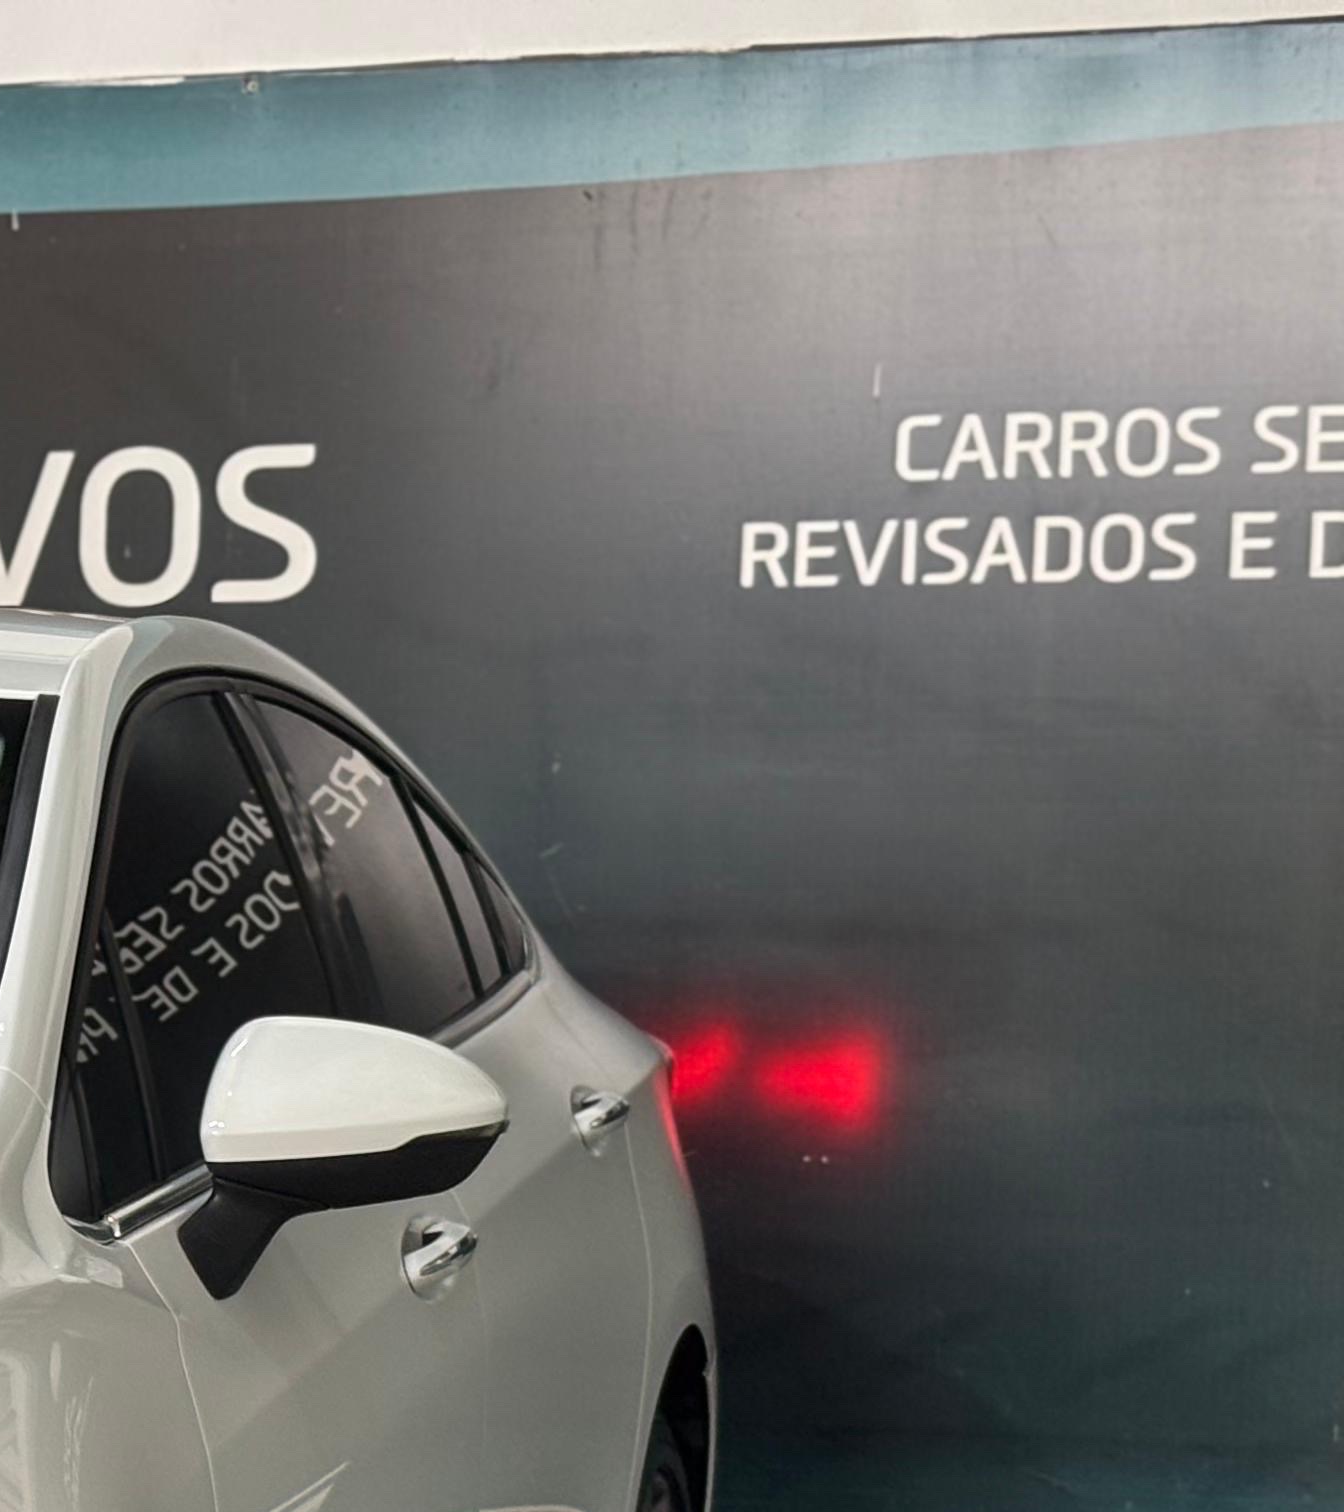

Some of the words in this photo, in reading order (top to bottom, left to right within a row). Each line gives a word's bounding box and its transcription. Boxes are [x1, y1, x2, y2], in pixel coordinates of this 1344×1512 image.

[895, 406, 1221, 481] CARROS
[739, 512, 1197, 588] REVISADOS
[1229, 511, 1278, 579] E
